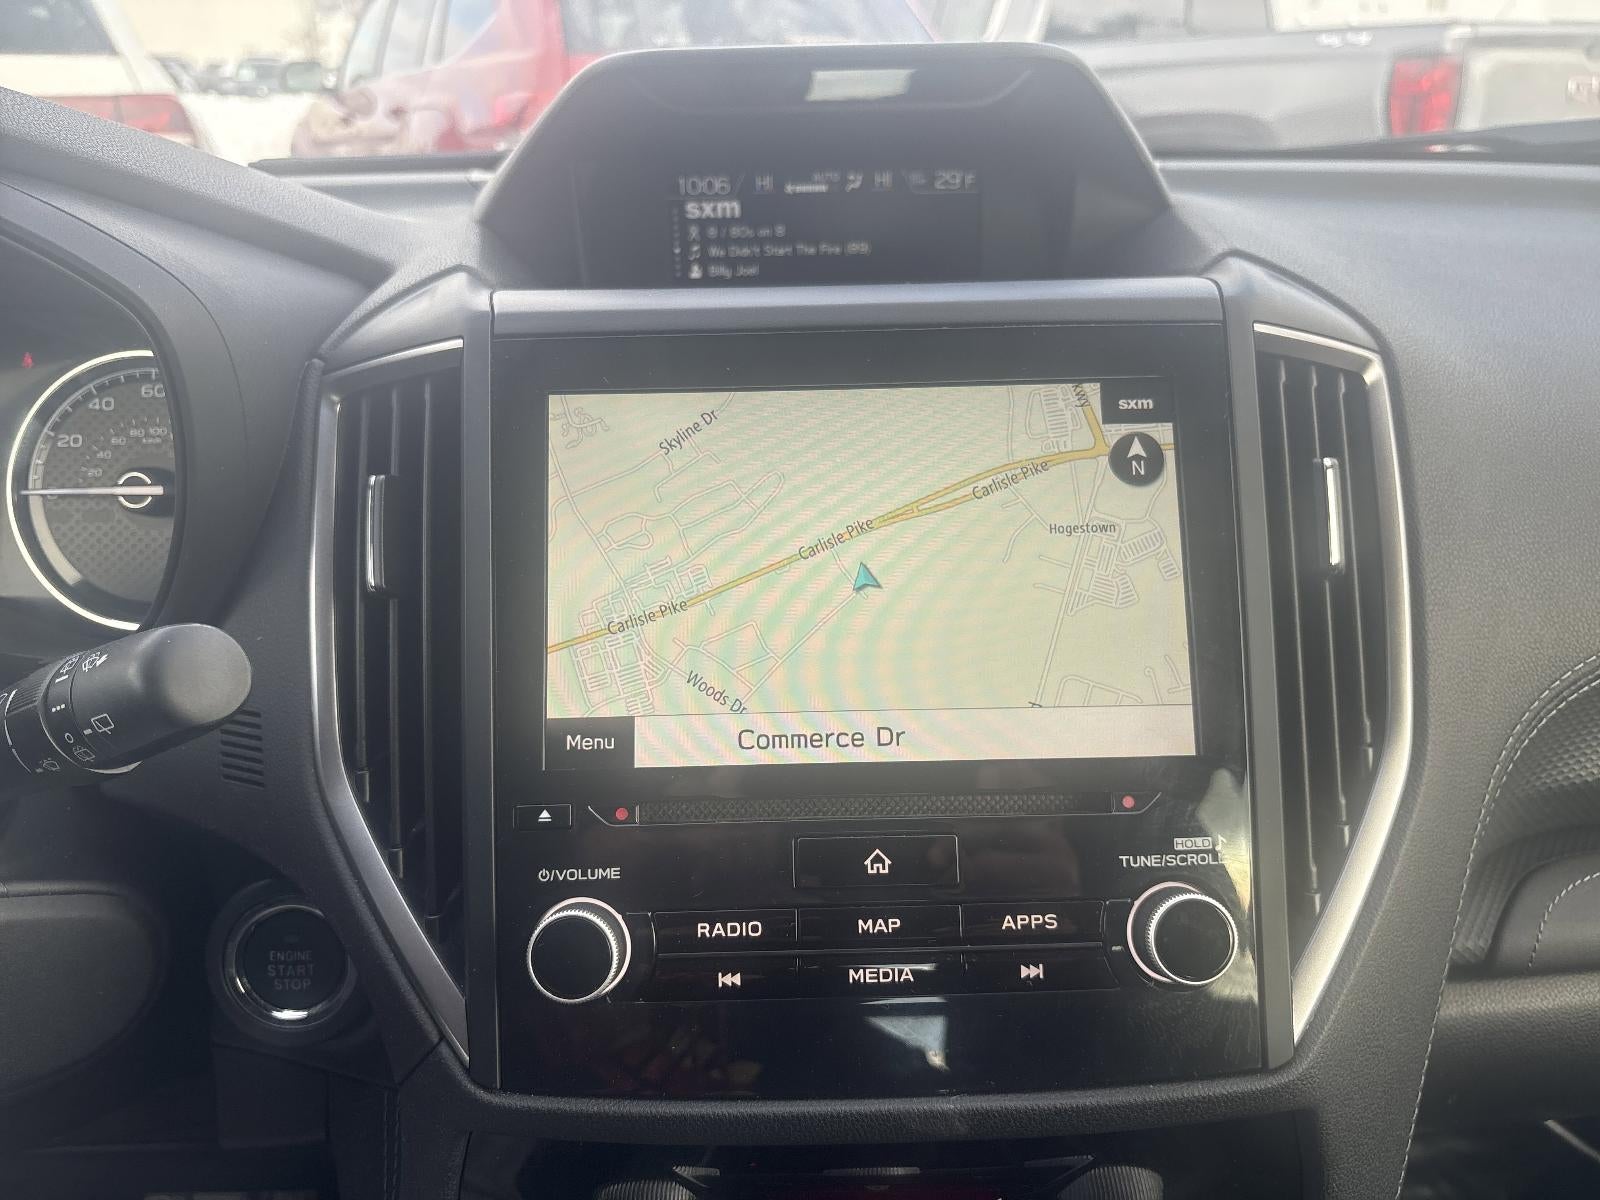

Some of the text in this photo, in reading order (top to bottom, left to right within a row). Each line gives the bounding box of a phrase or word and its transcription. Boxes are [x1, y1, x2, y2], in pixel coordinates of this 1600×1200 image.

[685, 200, 741, 219] sxm
[88, 397, 115, 412] 40
[1118, 398, 1153, 410] sxm
[57, 434, 83, 448] 20
[659, 409, 719, 456] Skyline Dr
[1131, 460, 1146, 475] N
[971, 458, 1050, 500] Carlisle Pike
[1050, 522, 1117, 537] Hogestown
[798, 517, 874, 561] Carlisle Pike
[607, 600, 689, 636] Carlisle Pike
[685, 670, 748, 714] Woods Dr
[566, 734, 616, 751] Menu
[737, 726, 906, 752] Commerce Dr
[1175, 838, 1211, 849] HOLD
[1119, 853, 1228, 868] TUNE/SCROLL
[697, 920, 763, 938] RADIO
[857, 918, 901, 935] MAP
[1001, 913, 1059, 931] APPS
[269, 950, 312, 961] ENGINE
[267, 964, 314, 977] START
[848, 966, 915, 985] MEDIA
[273, 978, 312, 990] STOP
